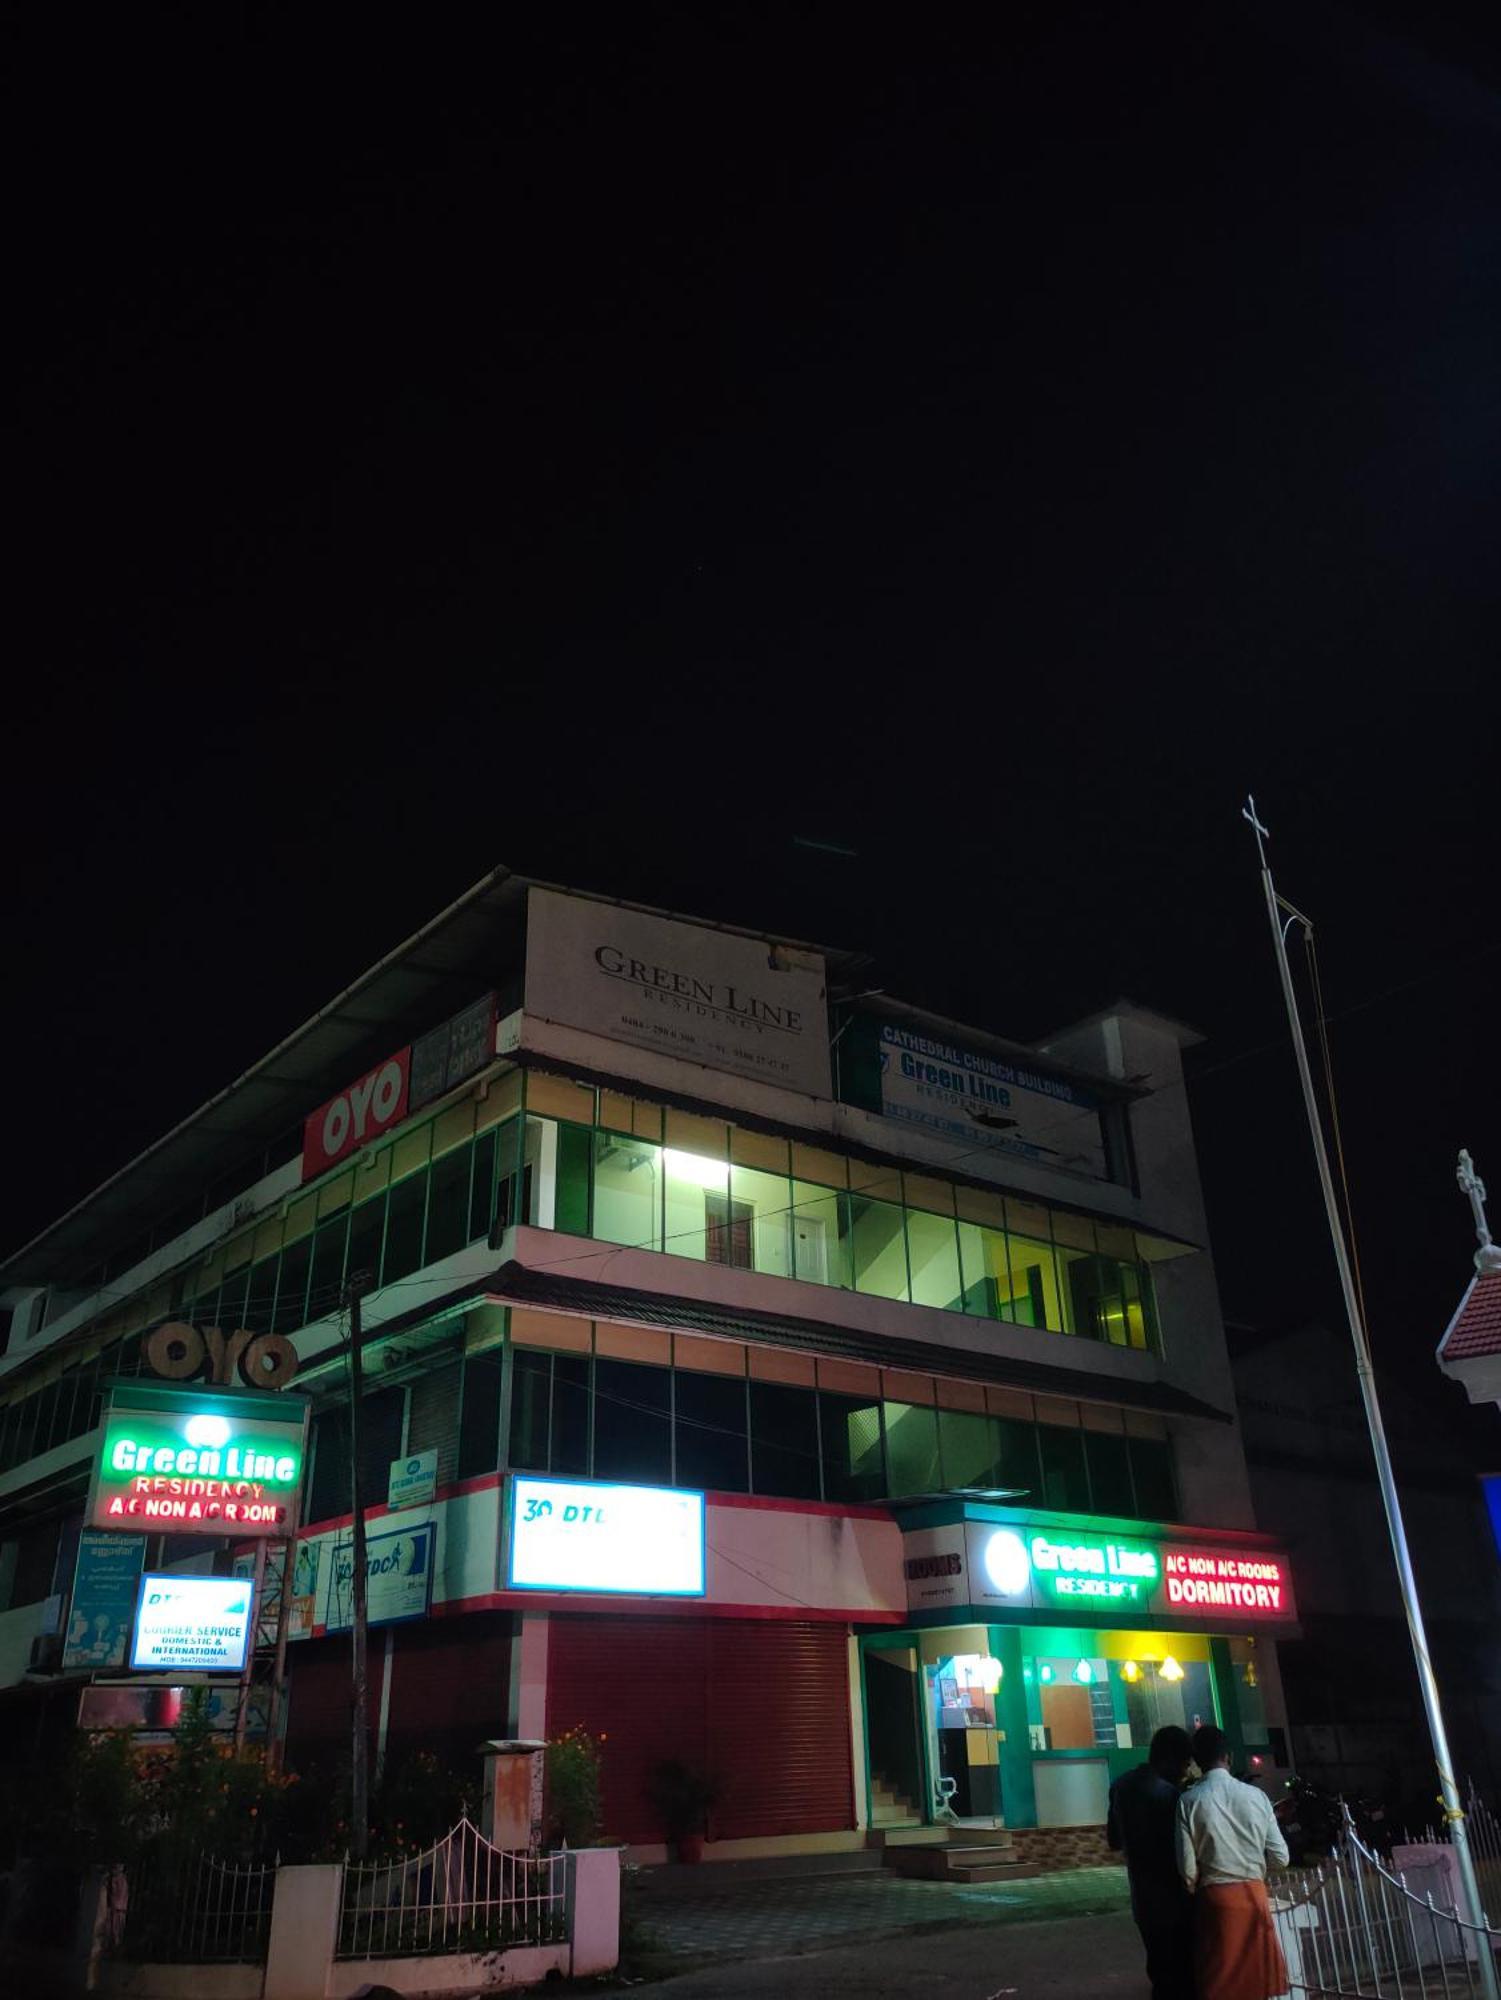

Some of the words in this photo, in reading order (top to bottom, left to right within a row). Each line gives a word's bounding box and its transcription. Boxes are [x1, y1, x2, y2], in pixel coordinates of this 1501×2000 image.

[595, 945, 713, 1004] GREEN
[728, 985, 802, 1032] LINE
[644, 988, 764, 1034] RESIDENCY
[882, 1025, 961, 1064] CATHEDRAL
[963, 1053, 1015, 1082] CHURCH
[1016, 1070, 1073, 1101] BUILDING
[901, 1052, 965, 1093] Green
[970, 1074, 1010, 1107] Line
[322, 1060, 403, 1157] OYO
[141, 1321, 299, 1390] OYO
[111, 1439, 222, 1477] Green
[225, 1447, 296, 1484] Line
[136, 1477, 264, 1500] RESIDENCY
[146, 1499, 186, 1518] NON
[1031, 1536, 1105, 1574] Green
[1106, 1544, 1157, 1578] Line
[1165, 1554, 1187, 1574] A/C
[1189, 1557, 1216, 1576] NON
[1217, 1559, 1237, 1577] A/C
[1238, 1562, 1281, 1581] ROOMS
[1055, 1576, 1139, 1600] RESIDENCY
[1168, 1578, 1281, 1609] DORMITORY
[161, 1636, 212, 1646] DOMESTIC
[197, 1625, 242, 1638] SERVICE
[151, 1645, 229, 1656] INTERNATIONAL
